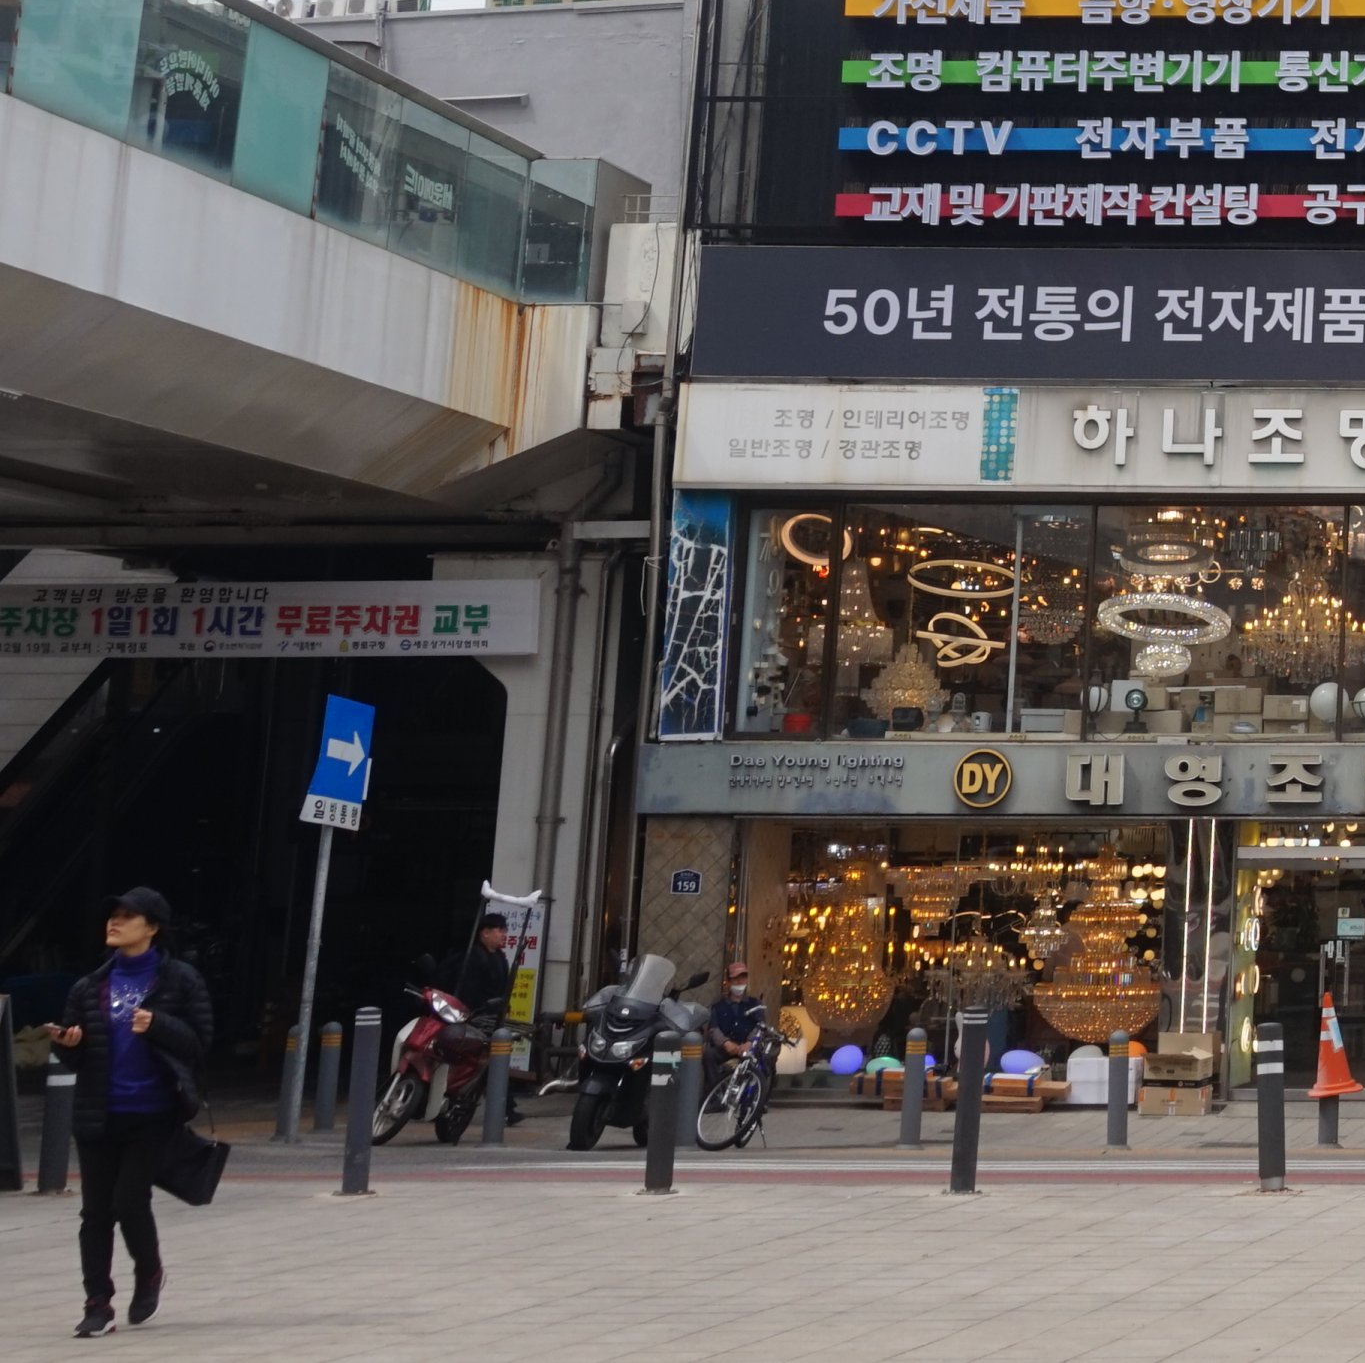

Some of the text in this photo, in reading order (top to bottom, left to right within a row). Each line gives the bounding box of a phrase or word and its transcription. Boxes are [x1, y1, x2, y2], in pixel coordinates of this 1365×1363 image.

[866, 52, 943, 93] 조명
[976, 52, 1242, 93] 컴퓨터주변기기
[867, 120, 1013, 155] CCTV
[1076, 118, 1250, 159] 전자부품
[864, 185, 941, 227] 교재
[950, 184, 986, 227] 및
[994, 184, 1143, 227] 기판제작
[1149, 183, 1259, 227] 컨설팅
[823, 284, 954, 340] 50년
[975, 285, 1132, 342] 전통의
[774, 410, 970, 430] 조명 인테리어조명
[728, 438, 923, 460] 일반조명 경관조명
[33, 588, 102, 603] 고객님의
[180, 587, 269, 603] 환영합니다
[0, 604, 490, 637] 주차장 1일1회 1시간 무료주차권 교부
[730, 754, 905, 769] Dae Young lighting
[961, 762, 1003, 795] DY
[677, 881, 696, 892] 159
